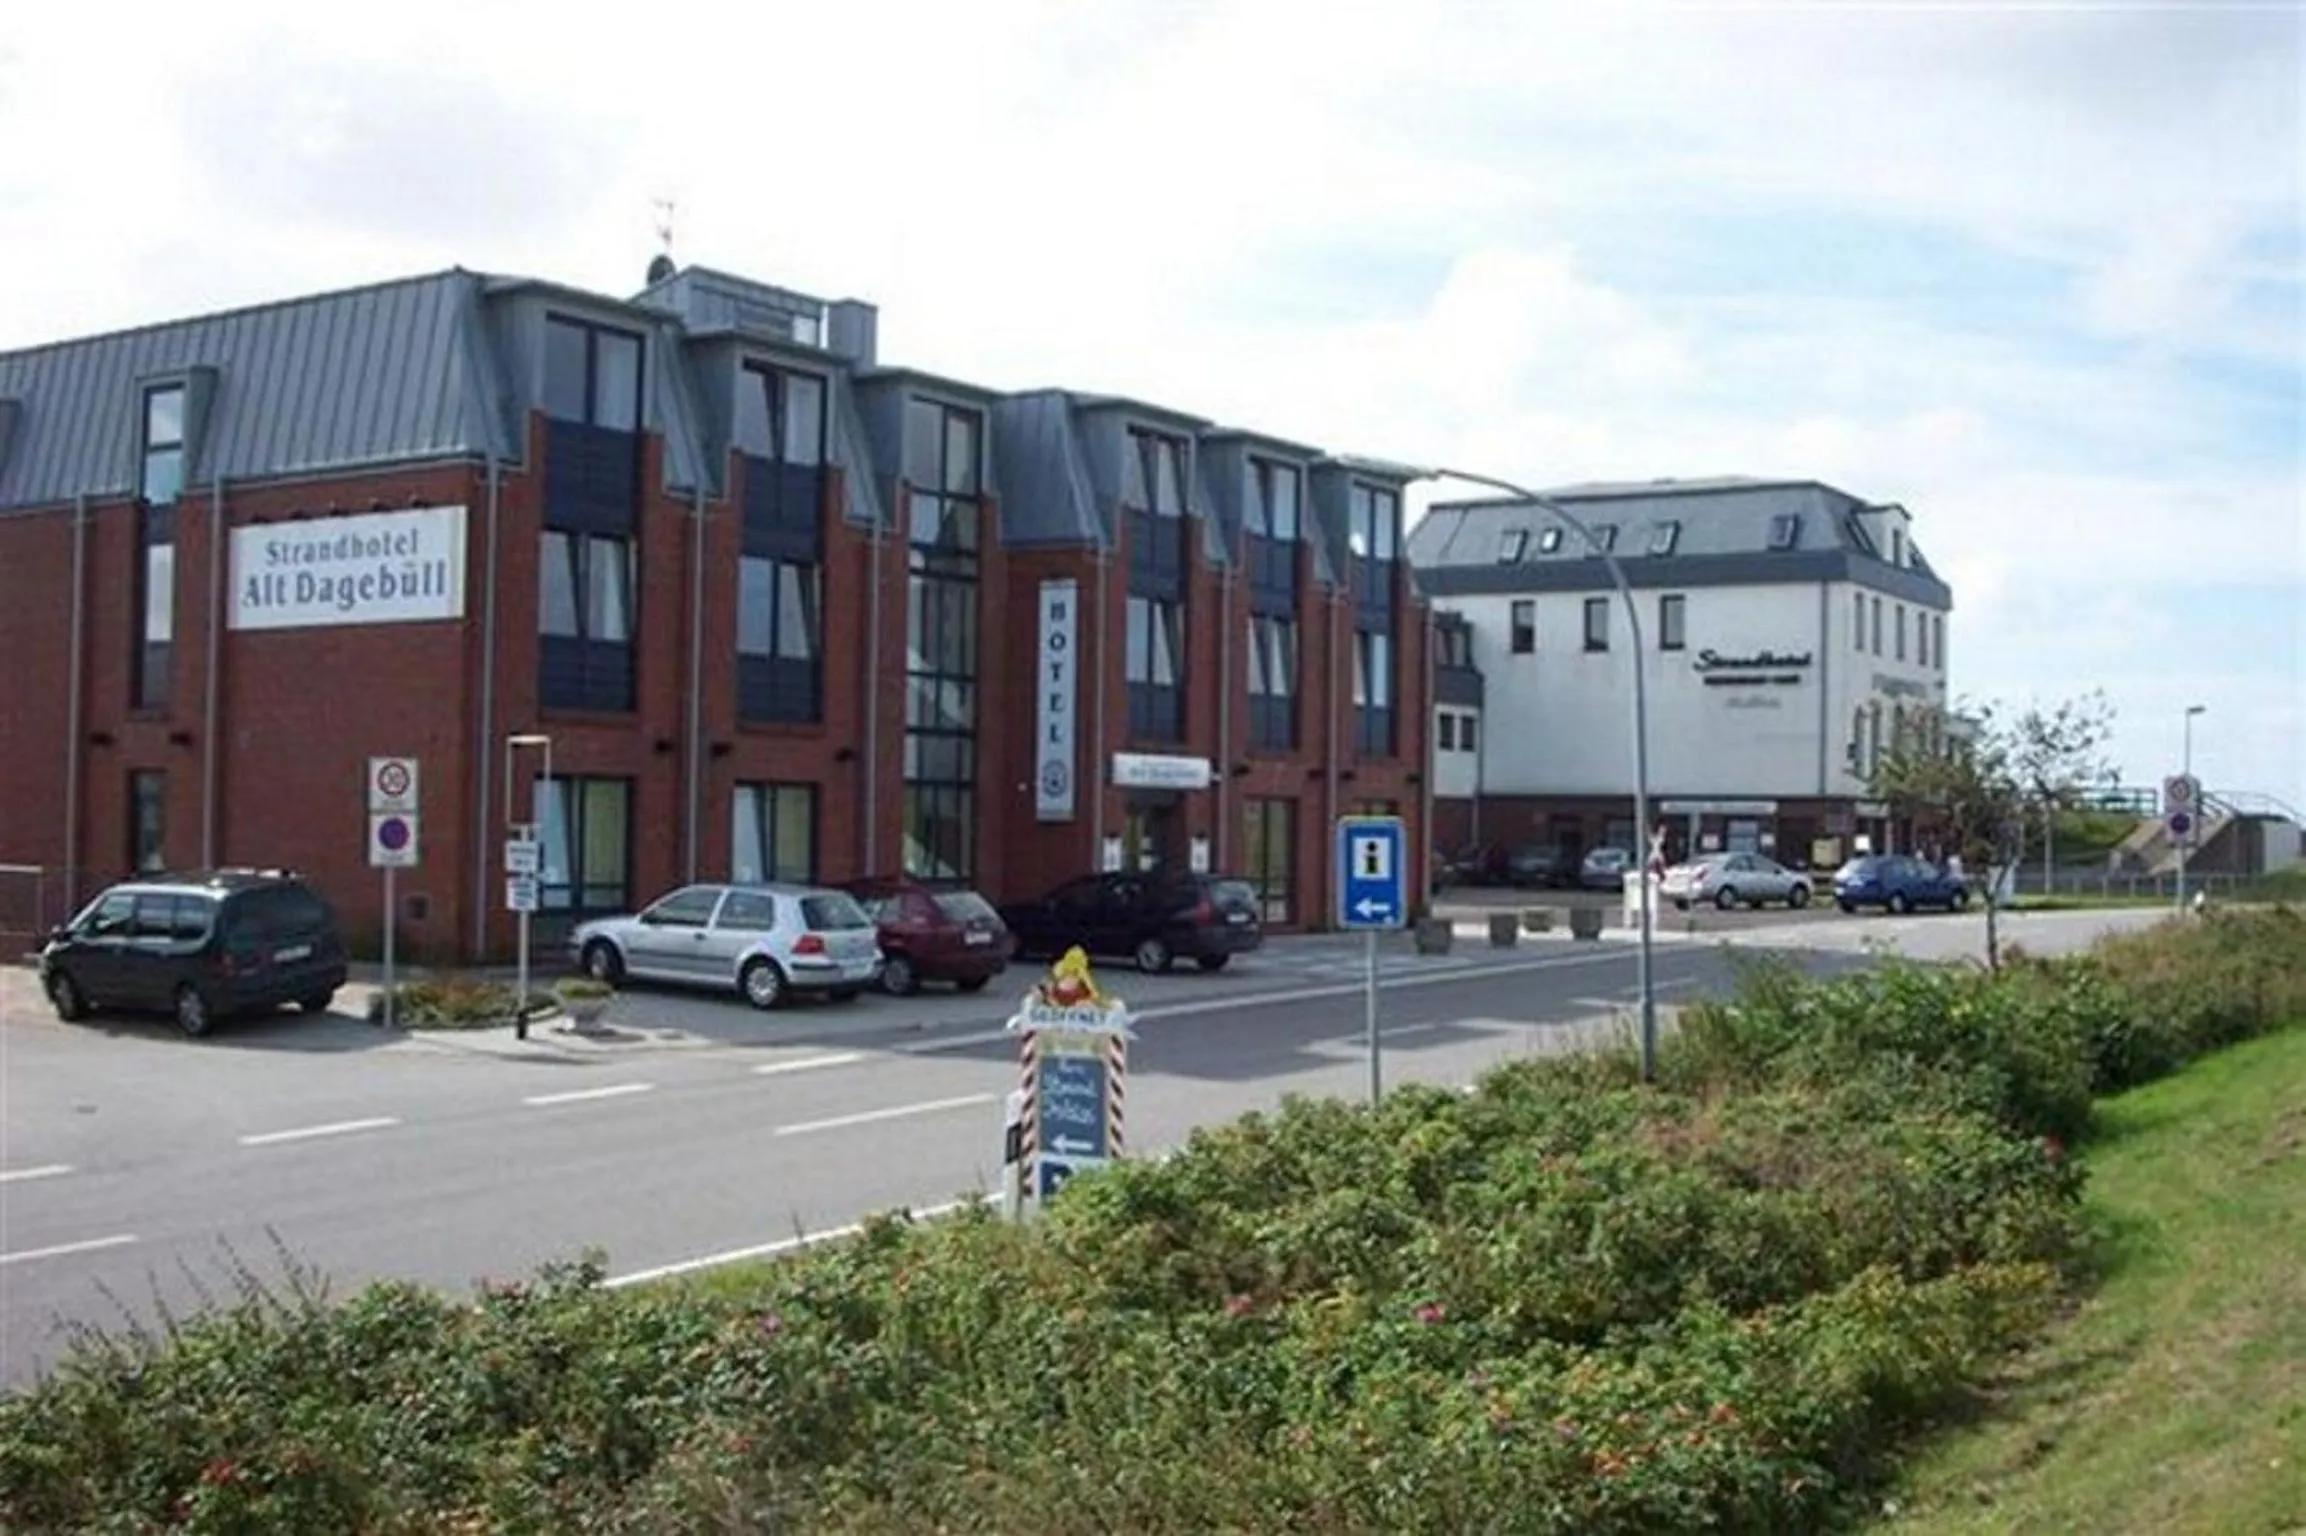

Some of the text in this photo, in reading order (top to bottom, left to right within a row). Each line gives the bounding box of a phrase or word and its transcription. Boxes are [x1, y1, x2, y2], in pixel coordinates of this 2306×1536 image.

[265, 528, 419, 566] Strandhotel
[242, 560, 446, 611] Alt Dagebüll
[1049, 601, 1067, 743] HOTEL
